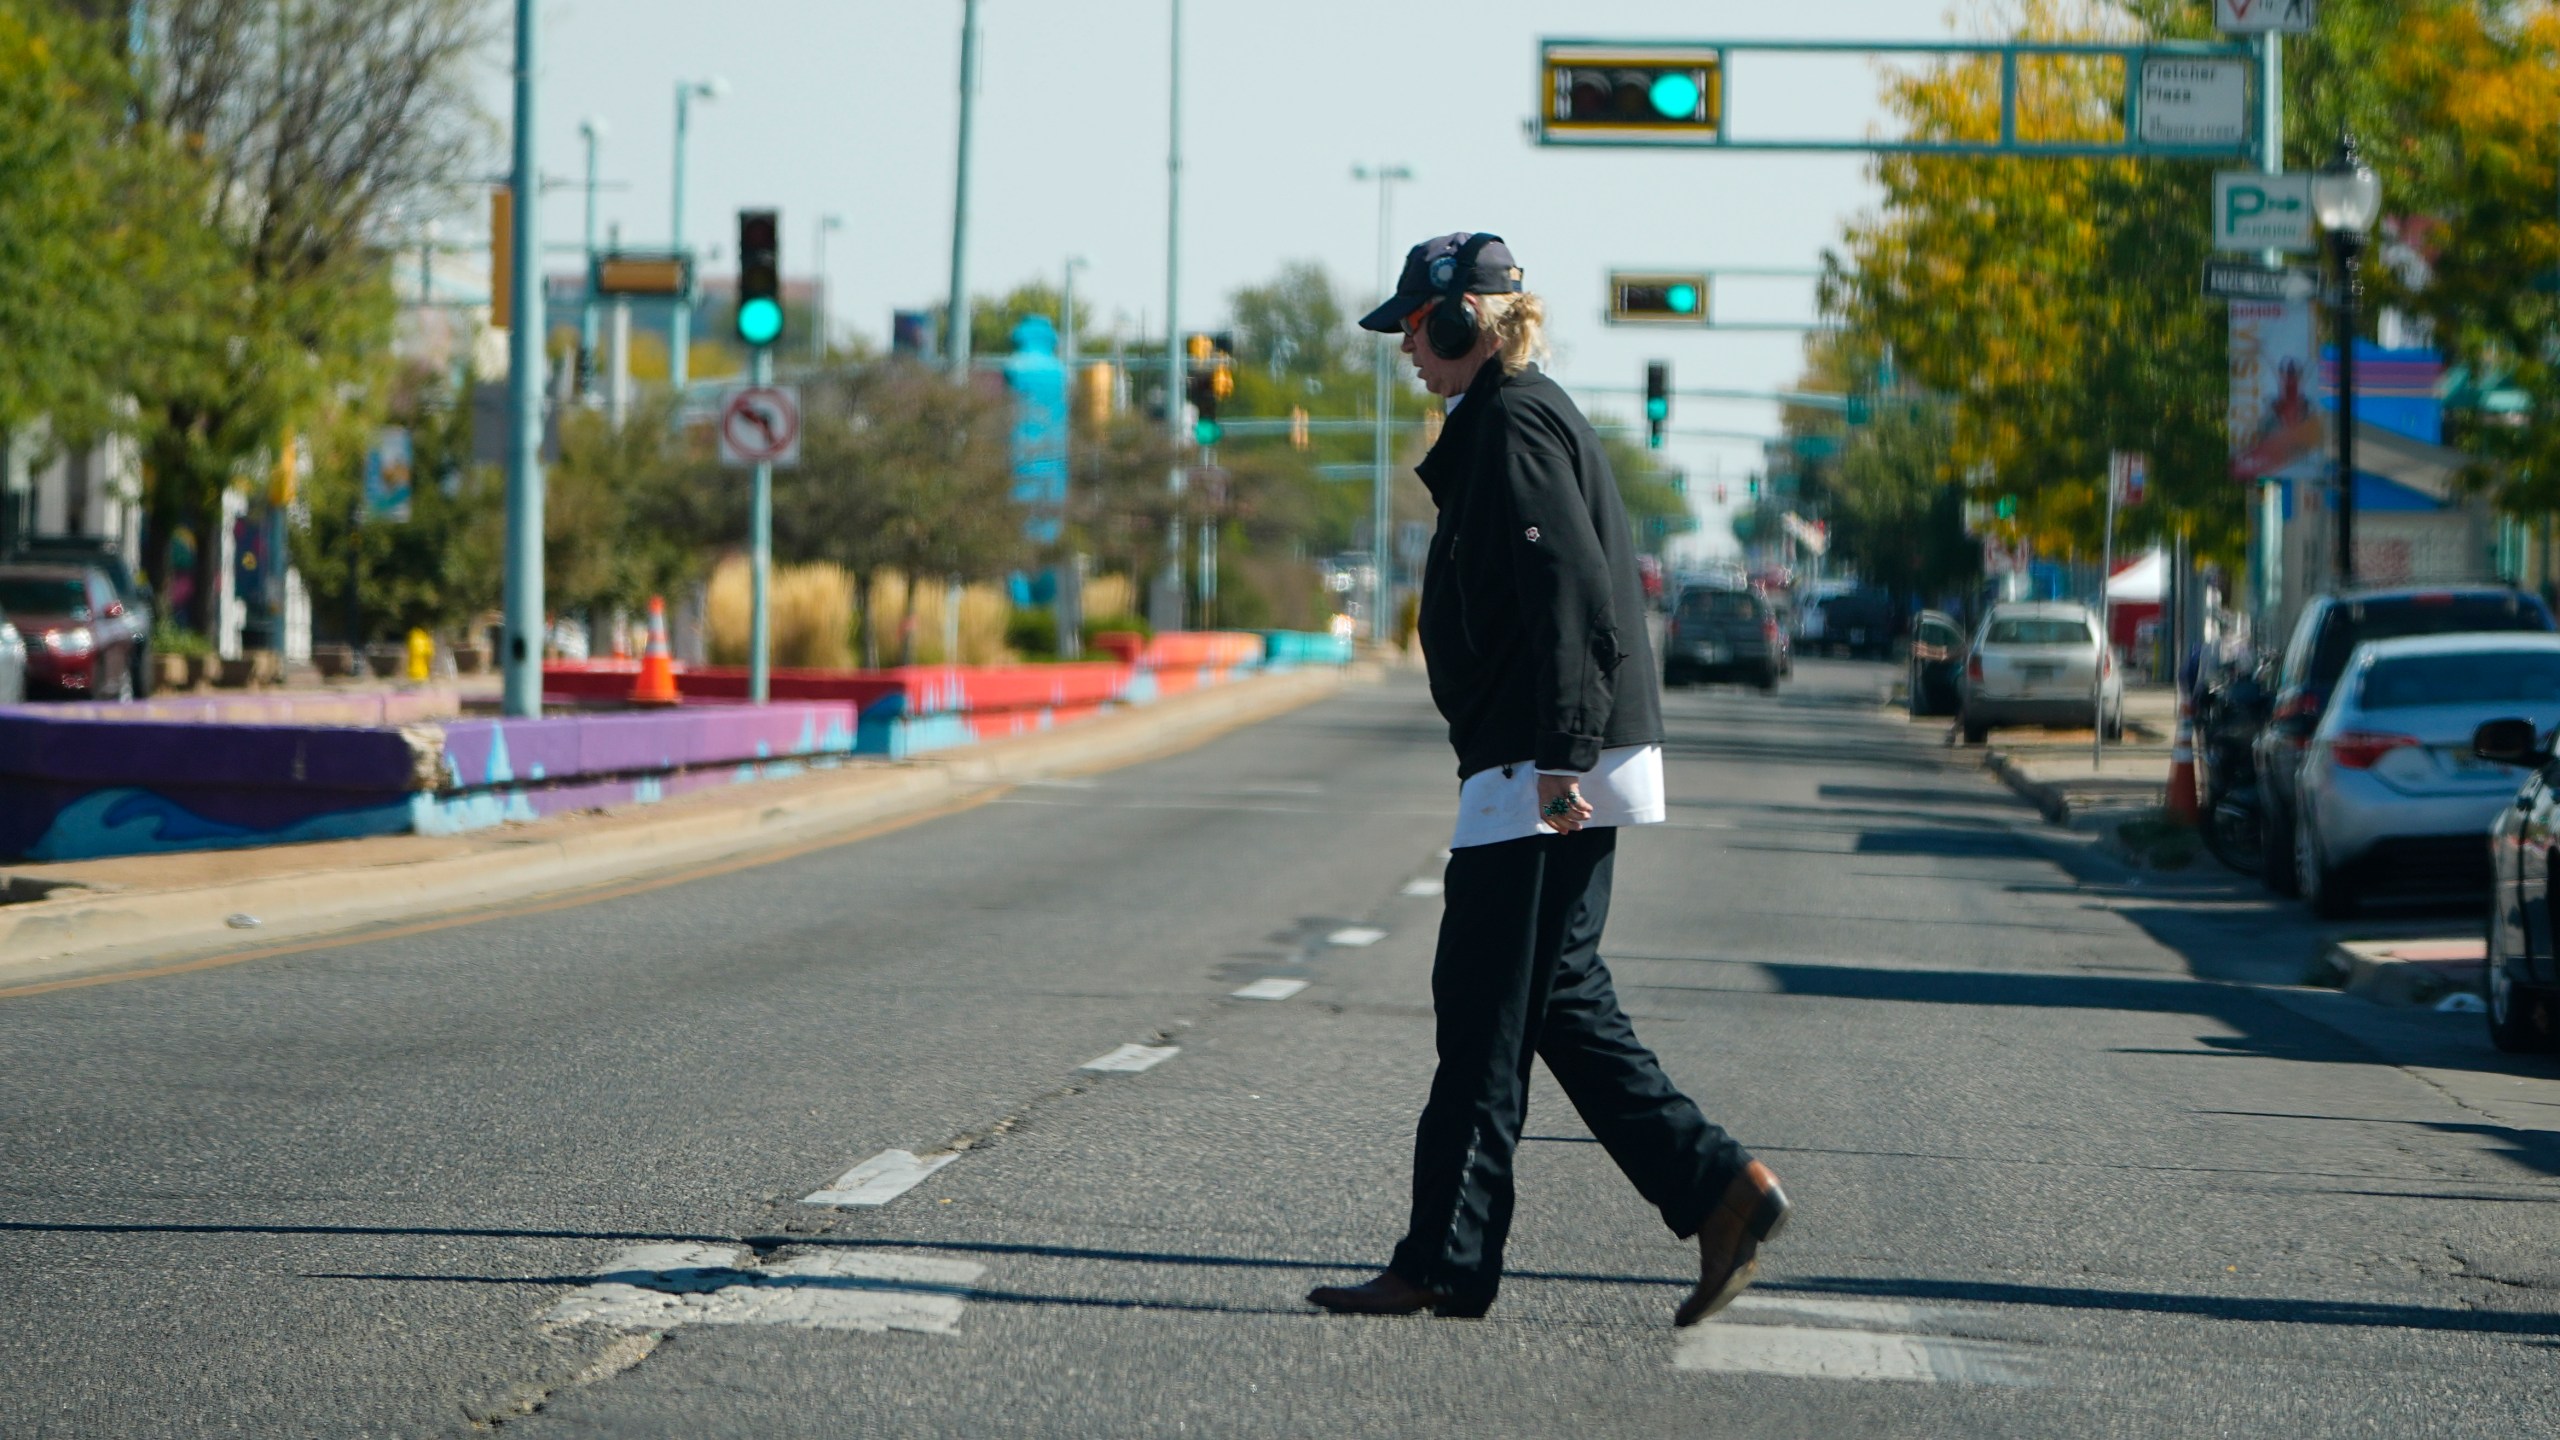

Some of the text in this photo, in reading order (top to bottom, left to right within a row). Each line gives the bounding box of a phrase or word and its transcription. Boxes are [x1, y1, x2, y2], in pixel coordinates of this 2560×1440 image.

[2147, 63, 2214, 80] Fletcher
[2147, 86, 2191, 102] Plaza
[2227, 186, 2266, 234] P
